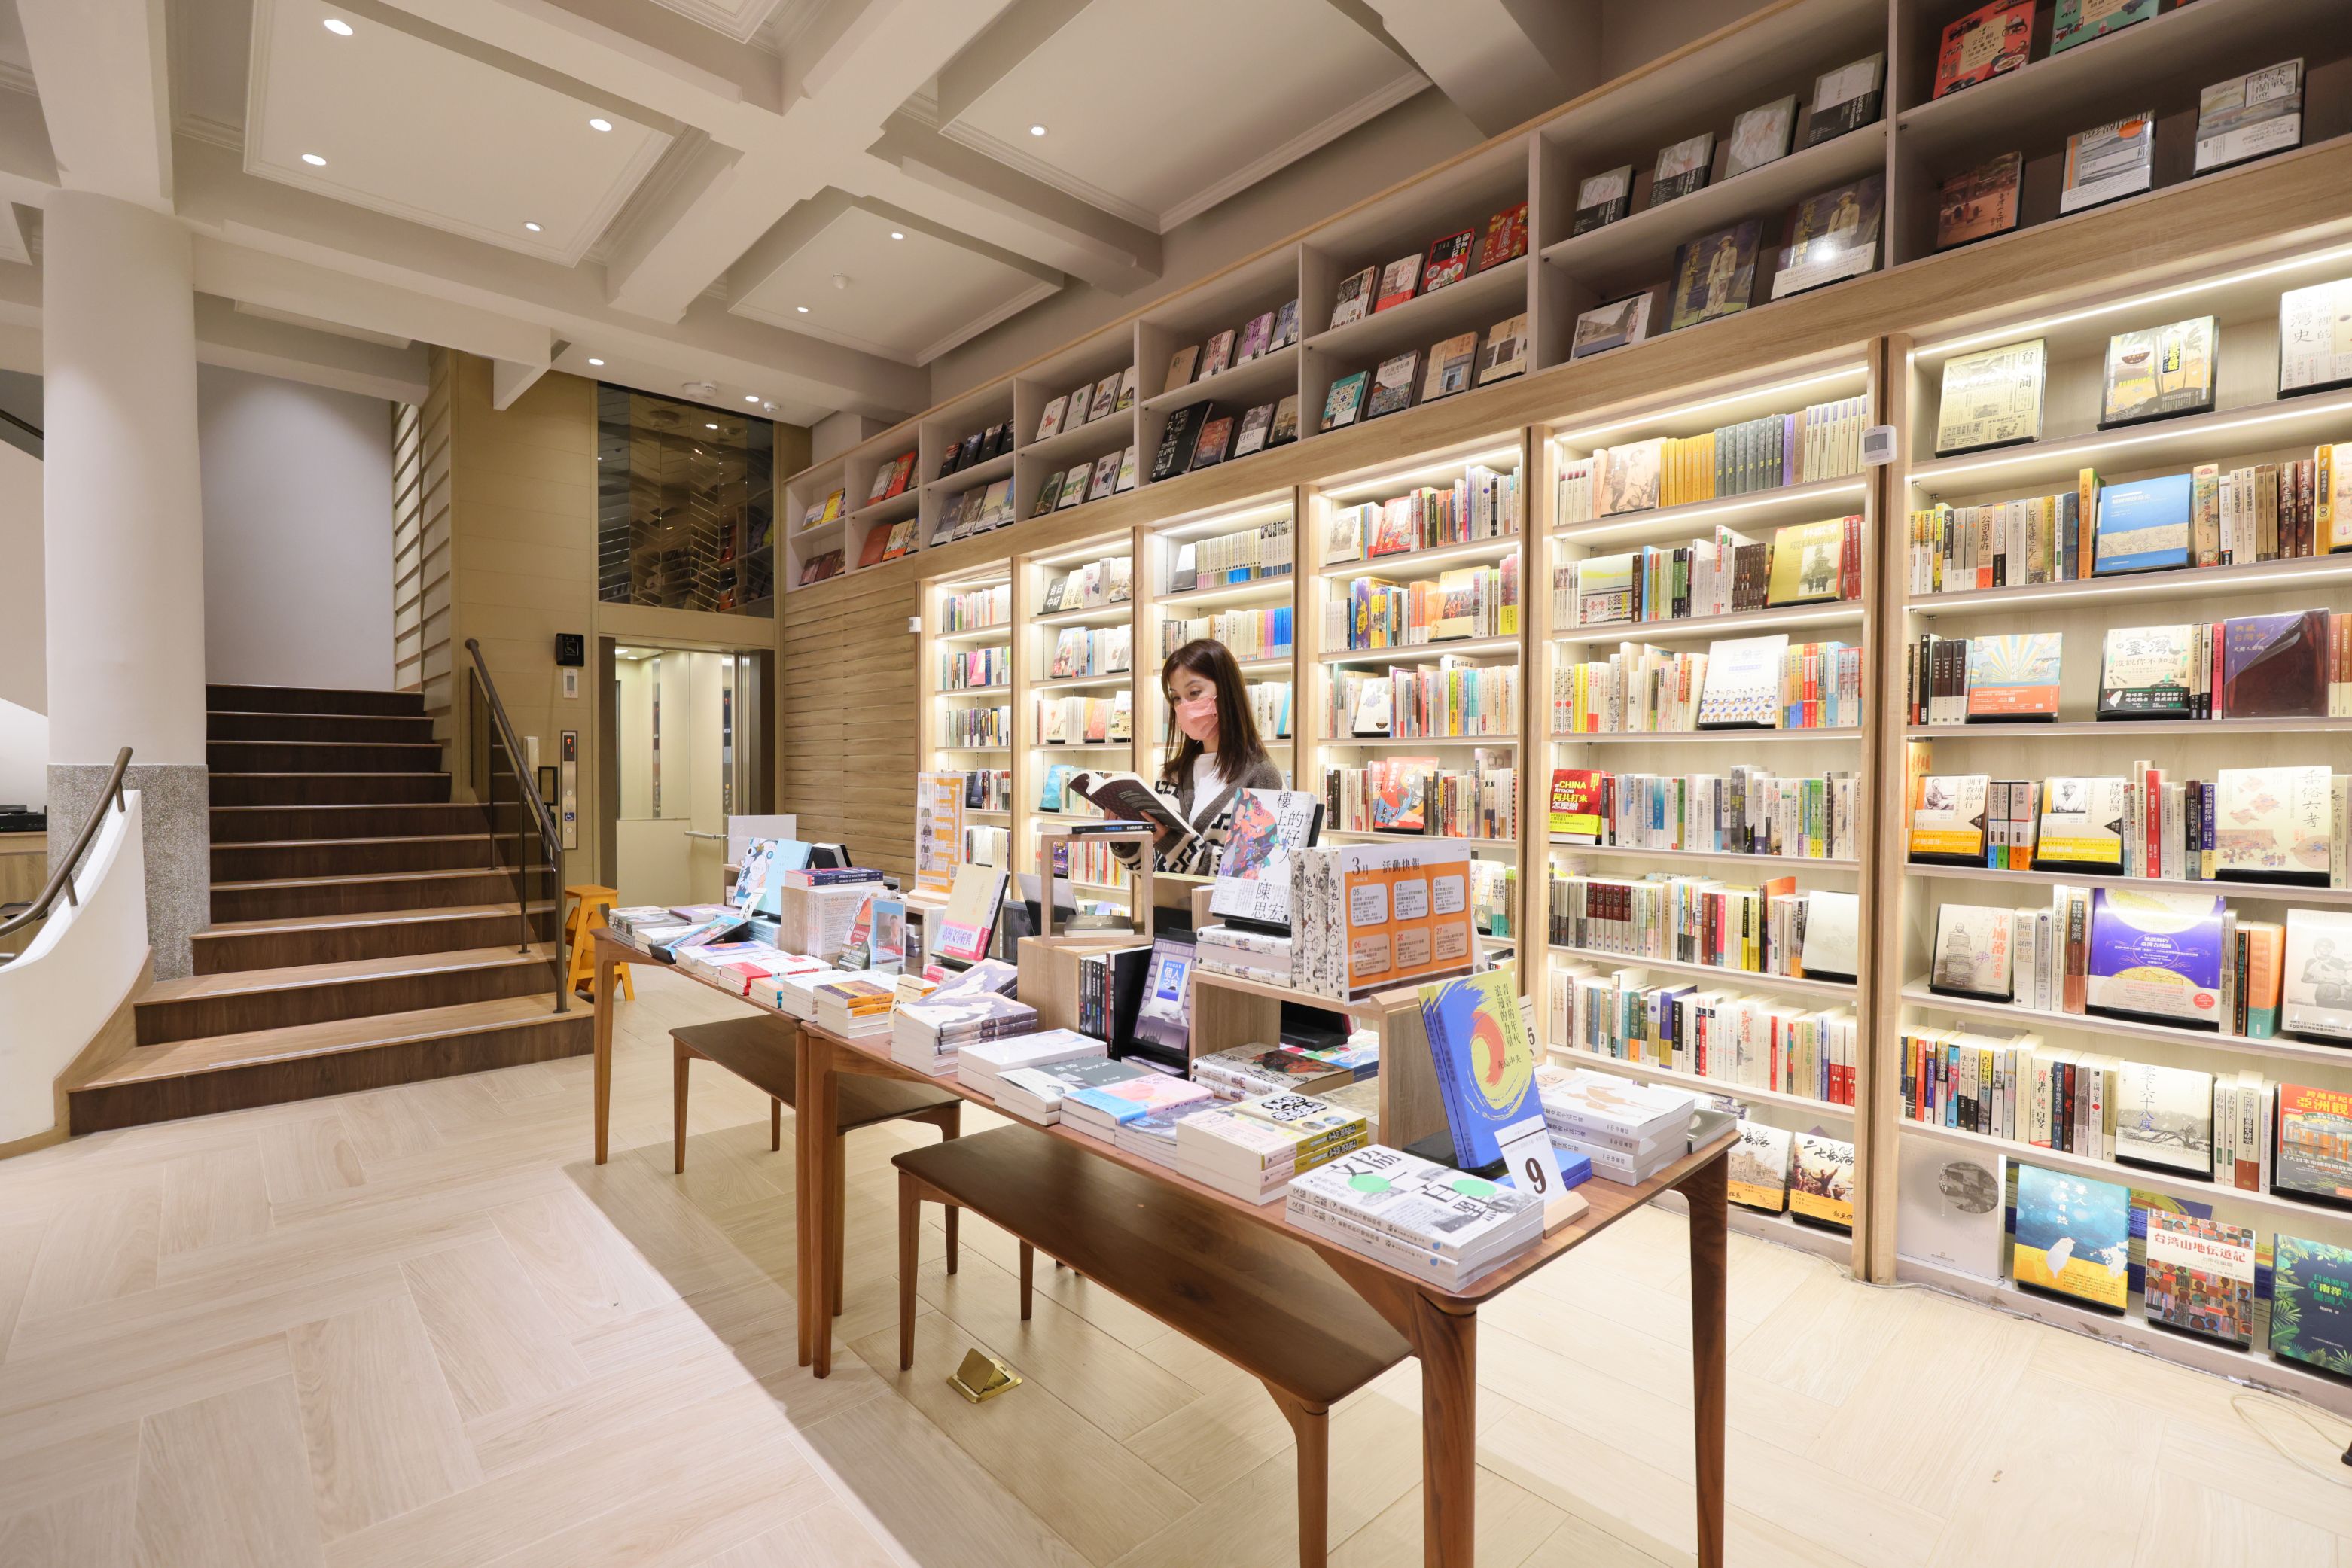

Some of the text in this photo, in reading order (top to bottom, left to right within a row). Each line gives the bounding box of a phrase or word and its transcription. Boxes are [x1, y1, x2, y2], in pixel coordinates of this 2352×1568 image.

[2125, 639, 2171, 656] 臺灣
[2115, 658, 2179, 667] 沒說你不知道
[1559, 781, 1586, 789] CHINA
[1277, 791, 1292, 827] 樓上
[1553, 793, 1588, 802] 阿共打來
[2299, 770, 2326, 827] 番俗六考
[1278, 810, 1304, 864] 的好人
[1351, 857, 1369, 876] 3月
[1382, 857, 1420, 874] 活動快報
[1304, 875, 1314, 910] 鬼地方
[1328, 878, 1339, 913] 鬼地方
[1164, 967, 1180, 981] 個人
[1494, 985, 1515, 1047] 浪漫的力量
[1503, 984, 1521, 1045] 青春的年代
[1528, 1027, 1535, 1046] 5
[1498, 1055, 1522, 1070] 在島中央
[2297, 1097, 2349, 1114] 亞洲觀
[1325, 1150, 1402, 1178] 文協
[1525, 1157, 1546, 1195] 9
[2154, 1232, 2247, 1263] 台湾山地伝道記
